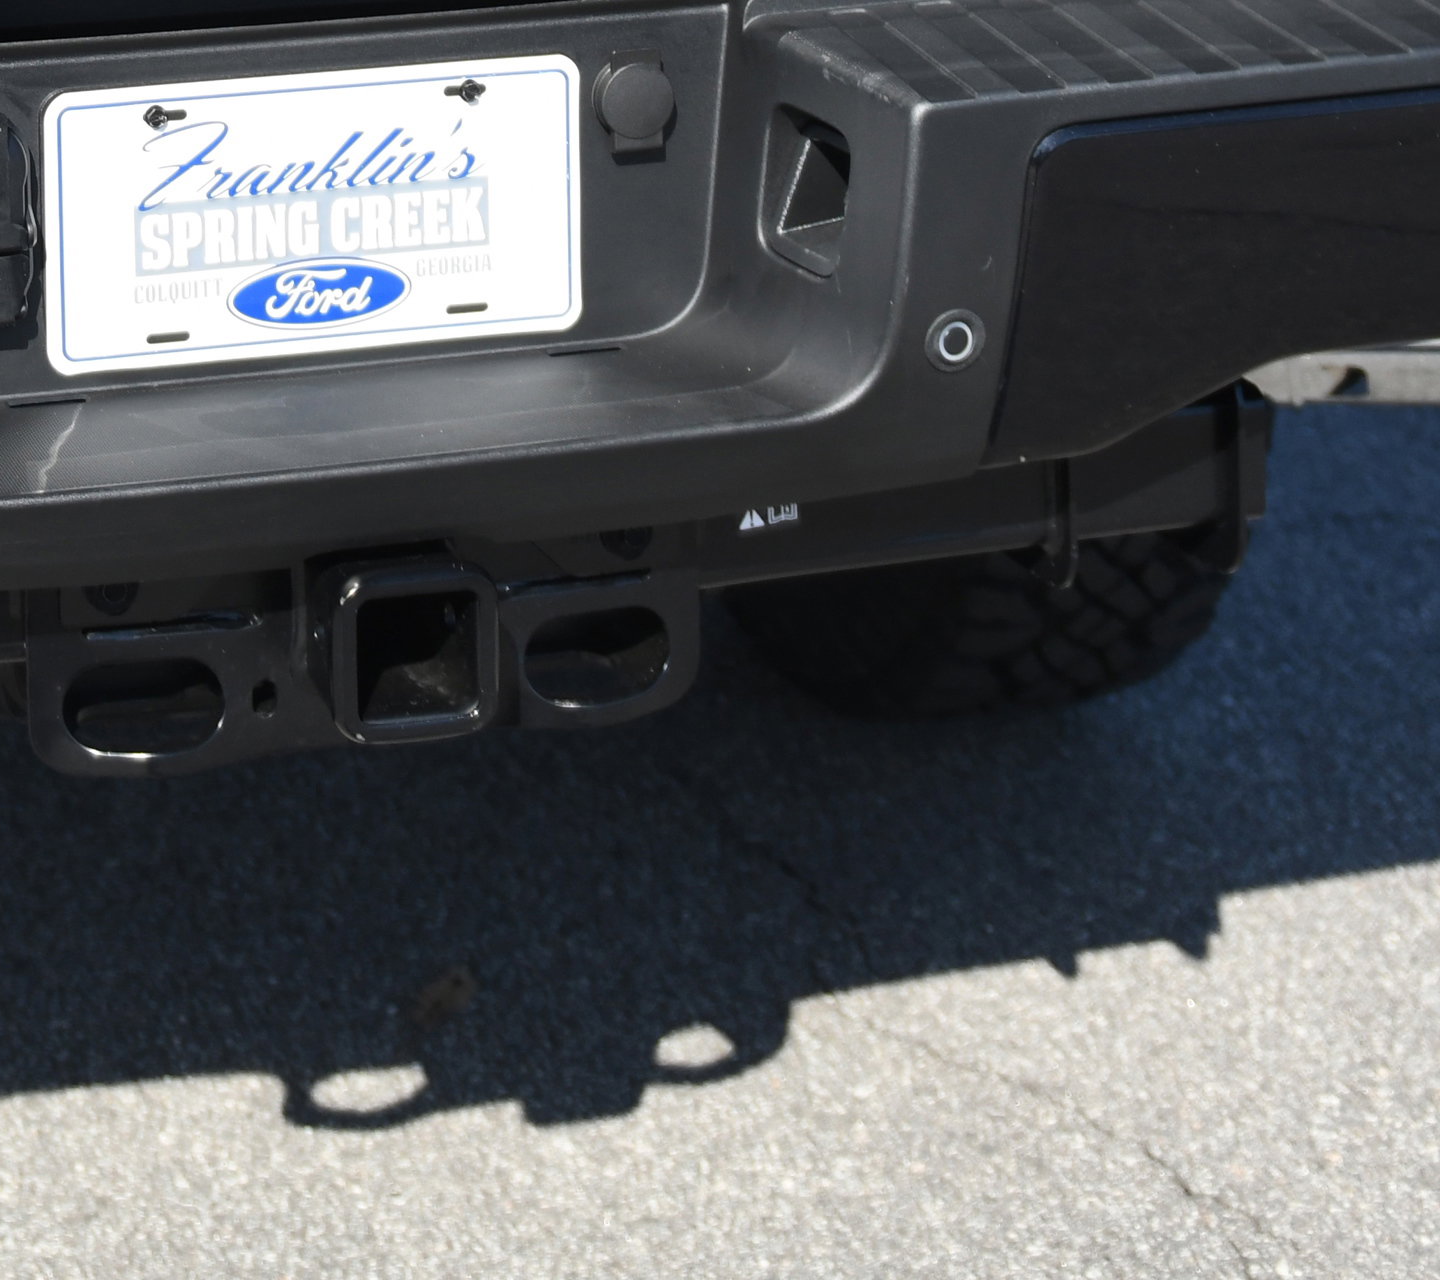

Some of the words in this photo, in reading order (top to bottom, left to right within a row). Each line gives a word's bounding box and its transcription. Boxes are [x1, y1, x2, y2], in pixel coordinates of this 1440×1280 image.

[137, 118, 486, 212] Franklin's
[140, 200, 320, 272] SPRING
[330, 185, 486, 253] CREEK
[416, 253, 493, 277] GEORGIA
[134, 278, 224, 305] COLQUITT
[265, 268, 374, 320] Ford
